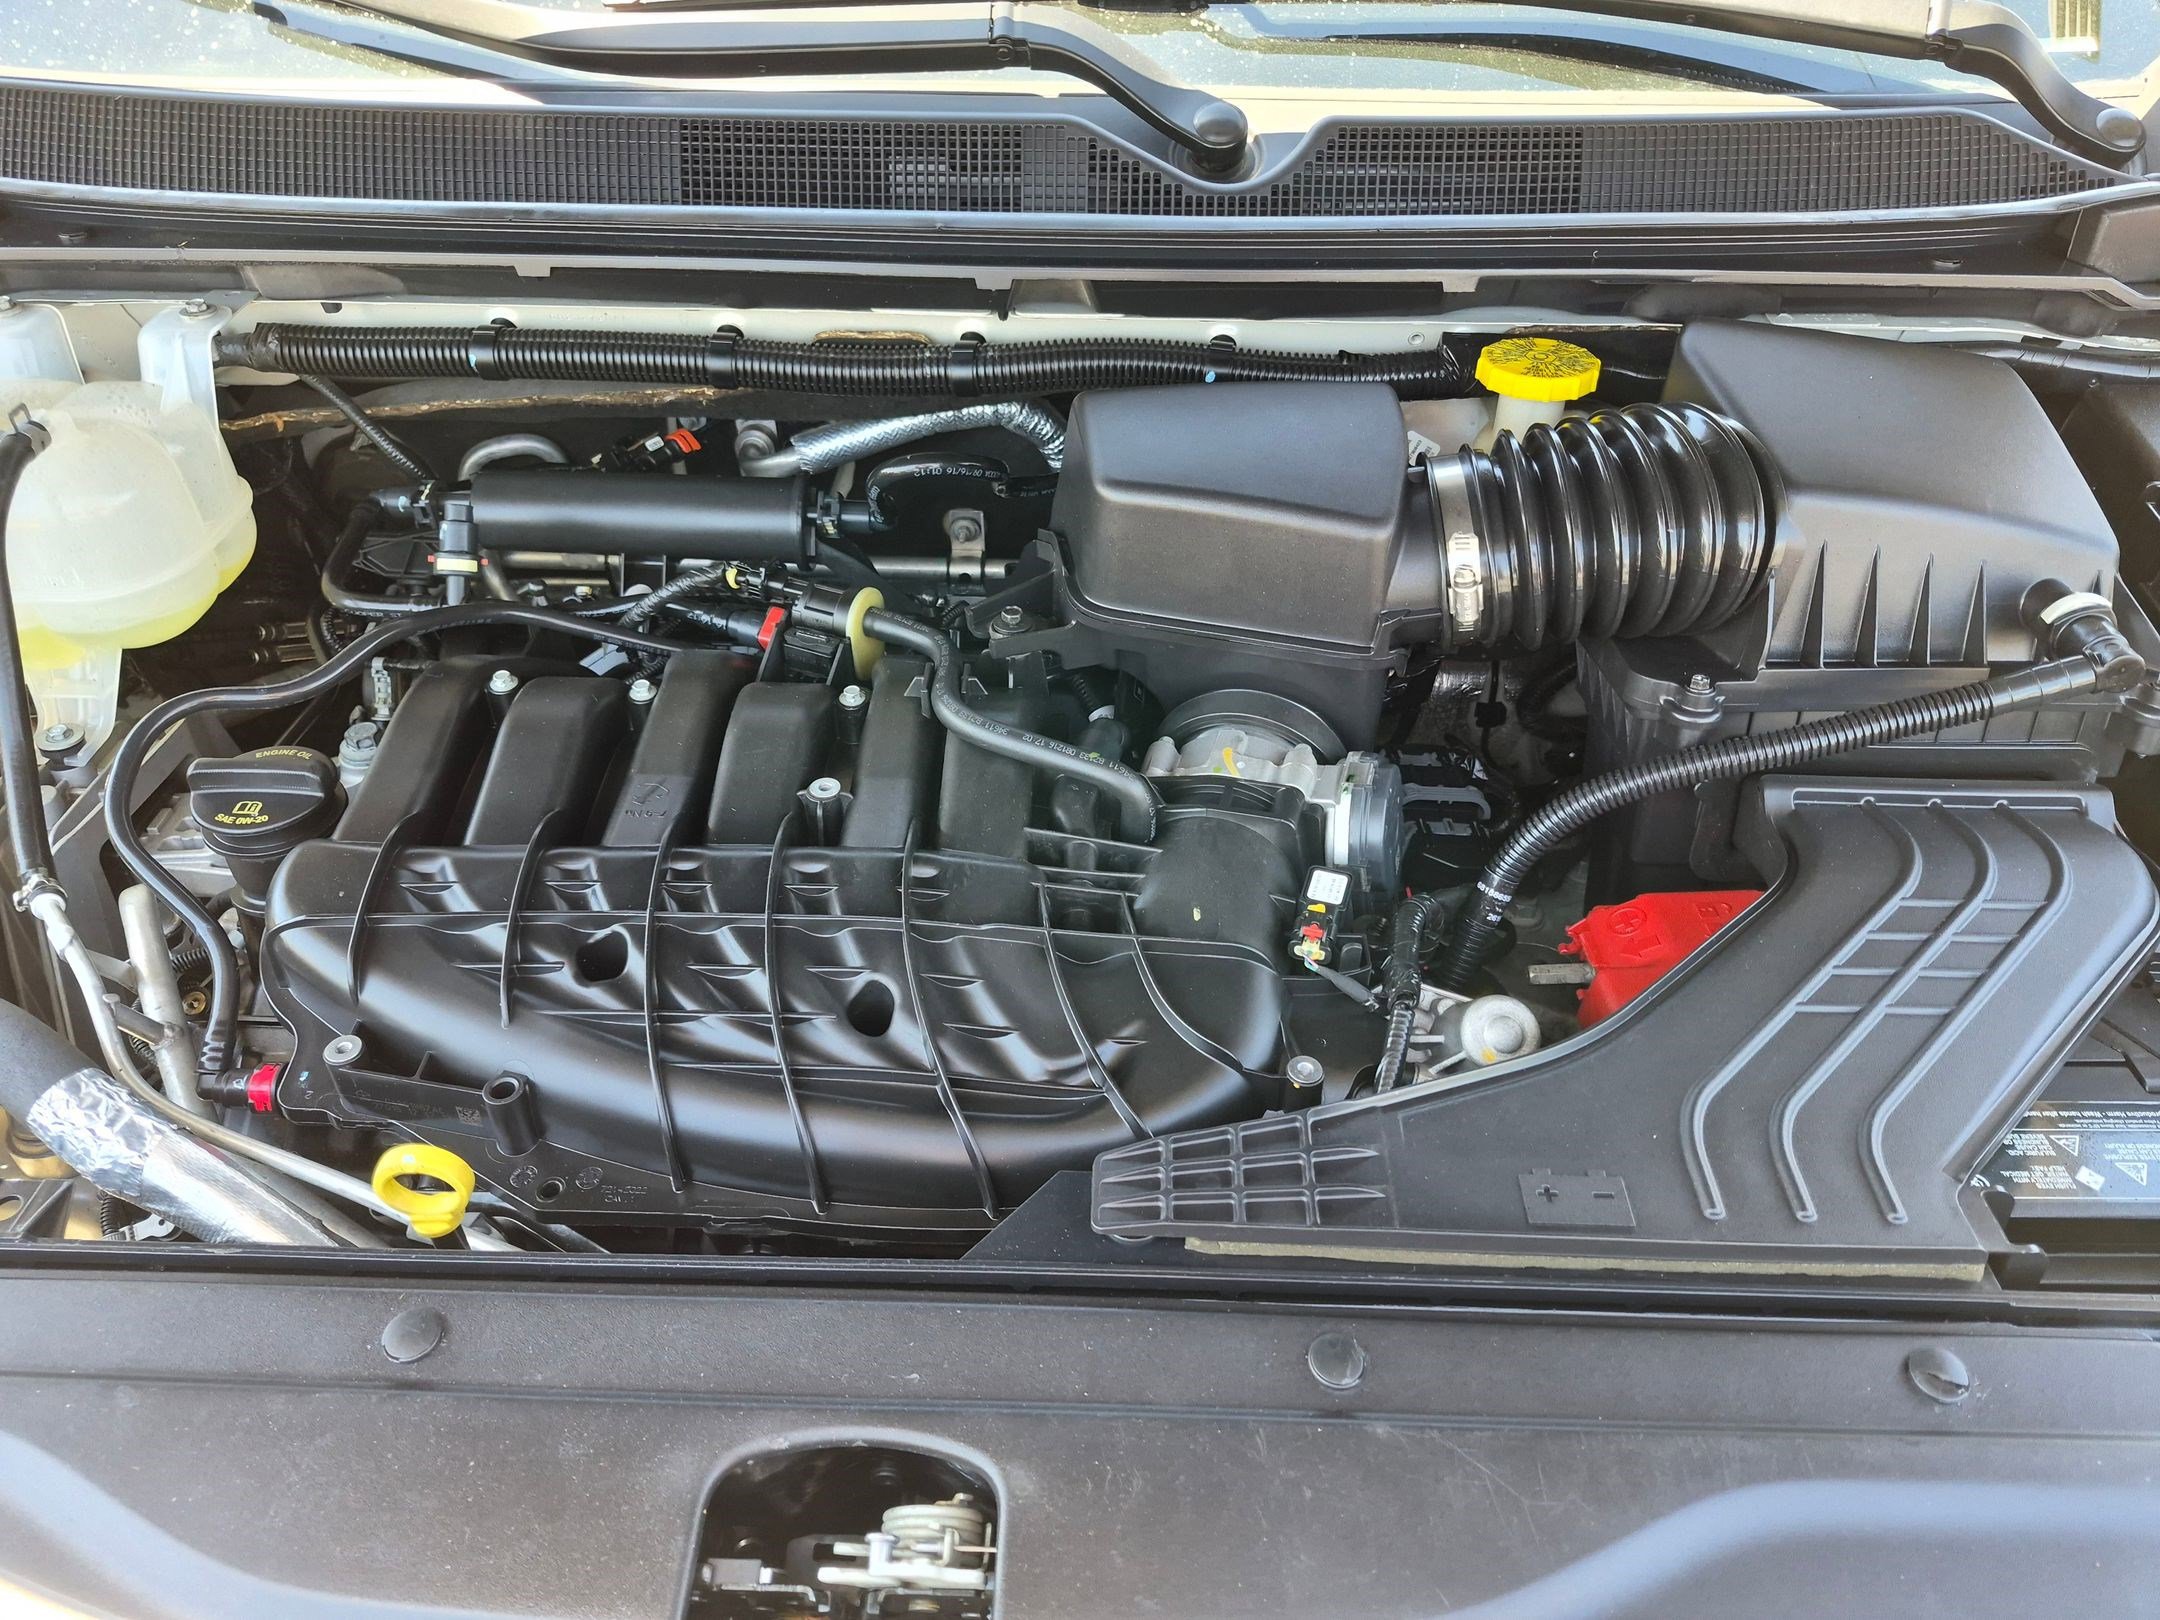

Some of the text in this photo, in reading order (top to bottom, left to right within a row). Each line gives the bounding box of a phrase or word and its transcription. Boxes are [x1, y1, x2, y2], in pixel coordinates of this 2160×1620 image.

[255, 749, 313, 760] ENGINE OIL
[215, 814, 269, 825] SAE 0W-20
